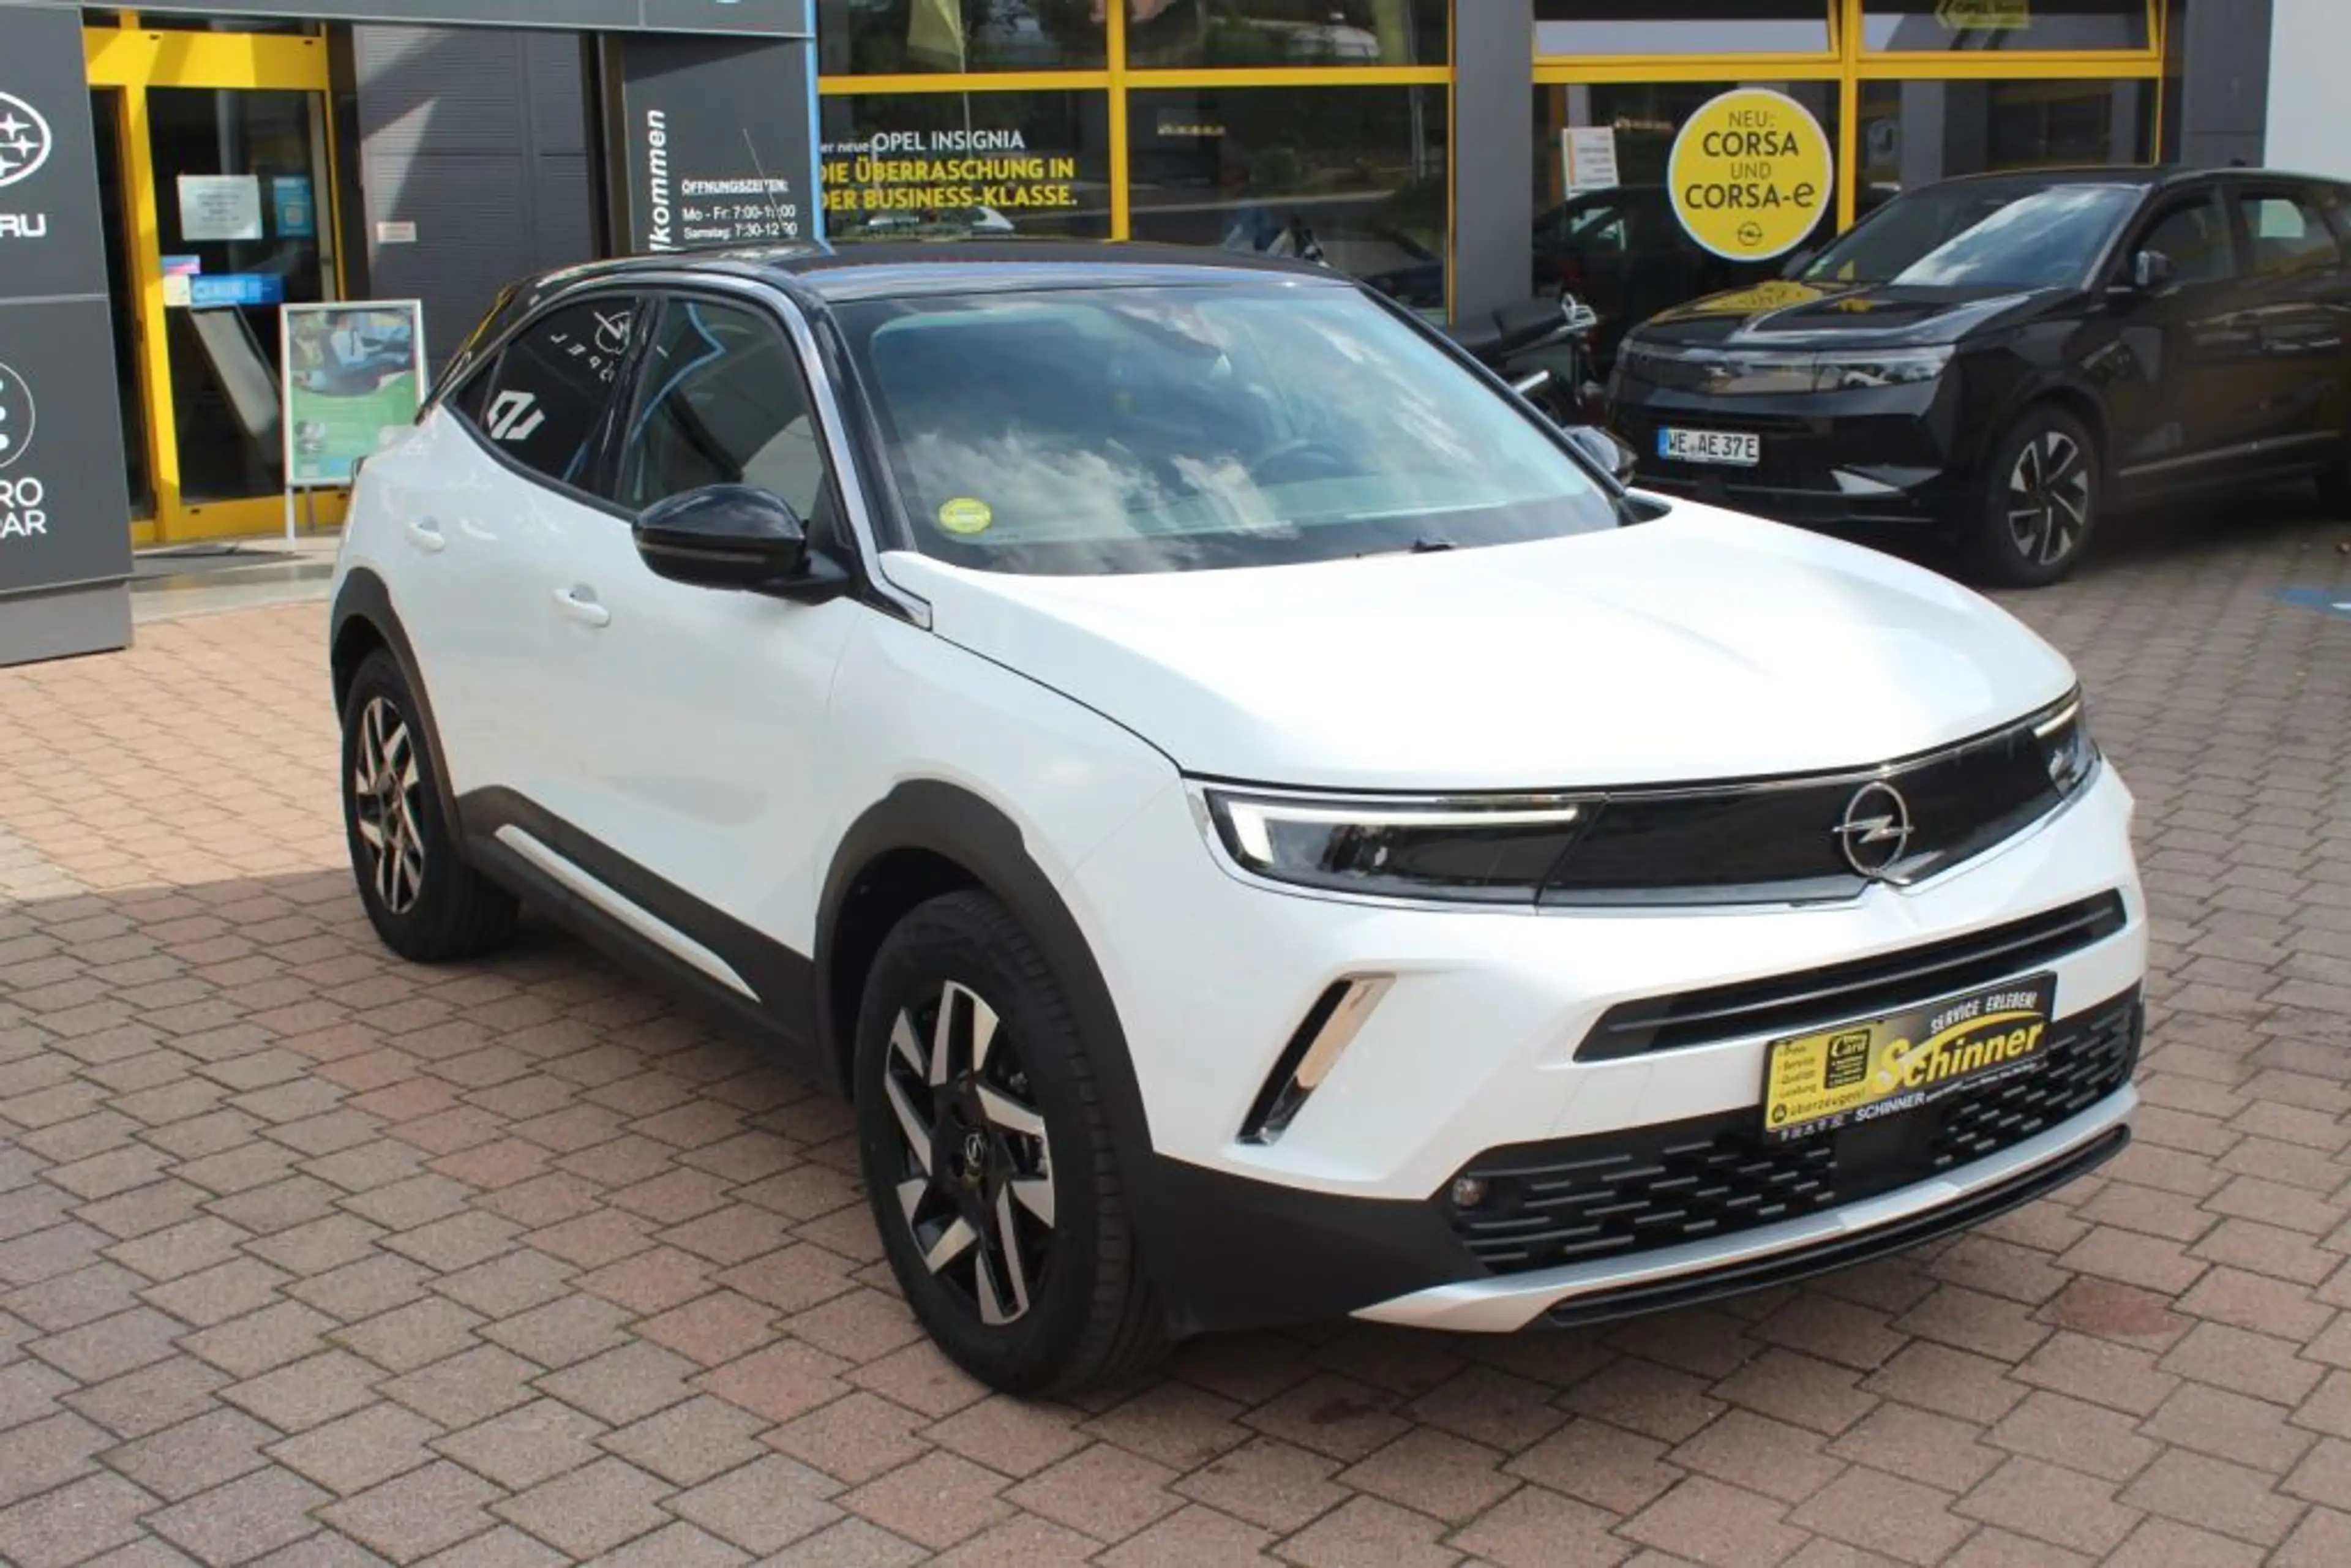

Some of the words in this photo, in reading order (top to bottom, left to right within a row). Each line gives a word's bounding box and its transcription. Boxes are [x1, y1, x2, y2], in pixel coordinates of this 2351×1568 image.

[838, 142, 869, 152] neue
[871, 131, 926, 152] OPEL
[931, 129, 1026, 151] INSIGNIA
[1703, 130, 1799, 157] CORSA
[855, 156, 1044, 183] ÜBERRASCHUNG
[1049, 157, 1074, 178] IN
[1731, 162, 1771, 180] UND
[863, 185, 1078, 210] BUSINESS-KLASSE.
[1685, 182, 1815, 209] CORSA-e
[0, 509, 47, 539] AR
[1930, 999, 1980, 1035] SERVICE
[1872, 1021, 2045, 1095] Schinner
[1855, 1092, 1925, 1122] SCHINNER
